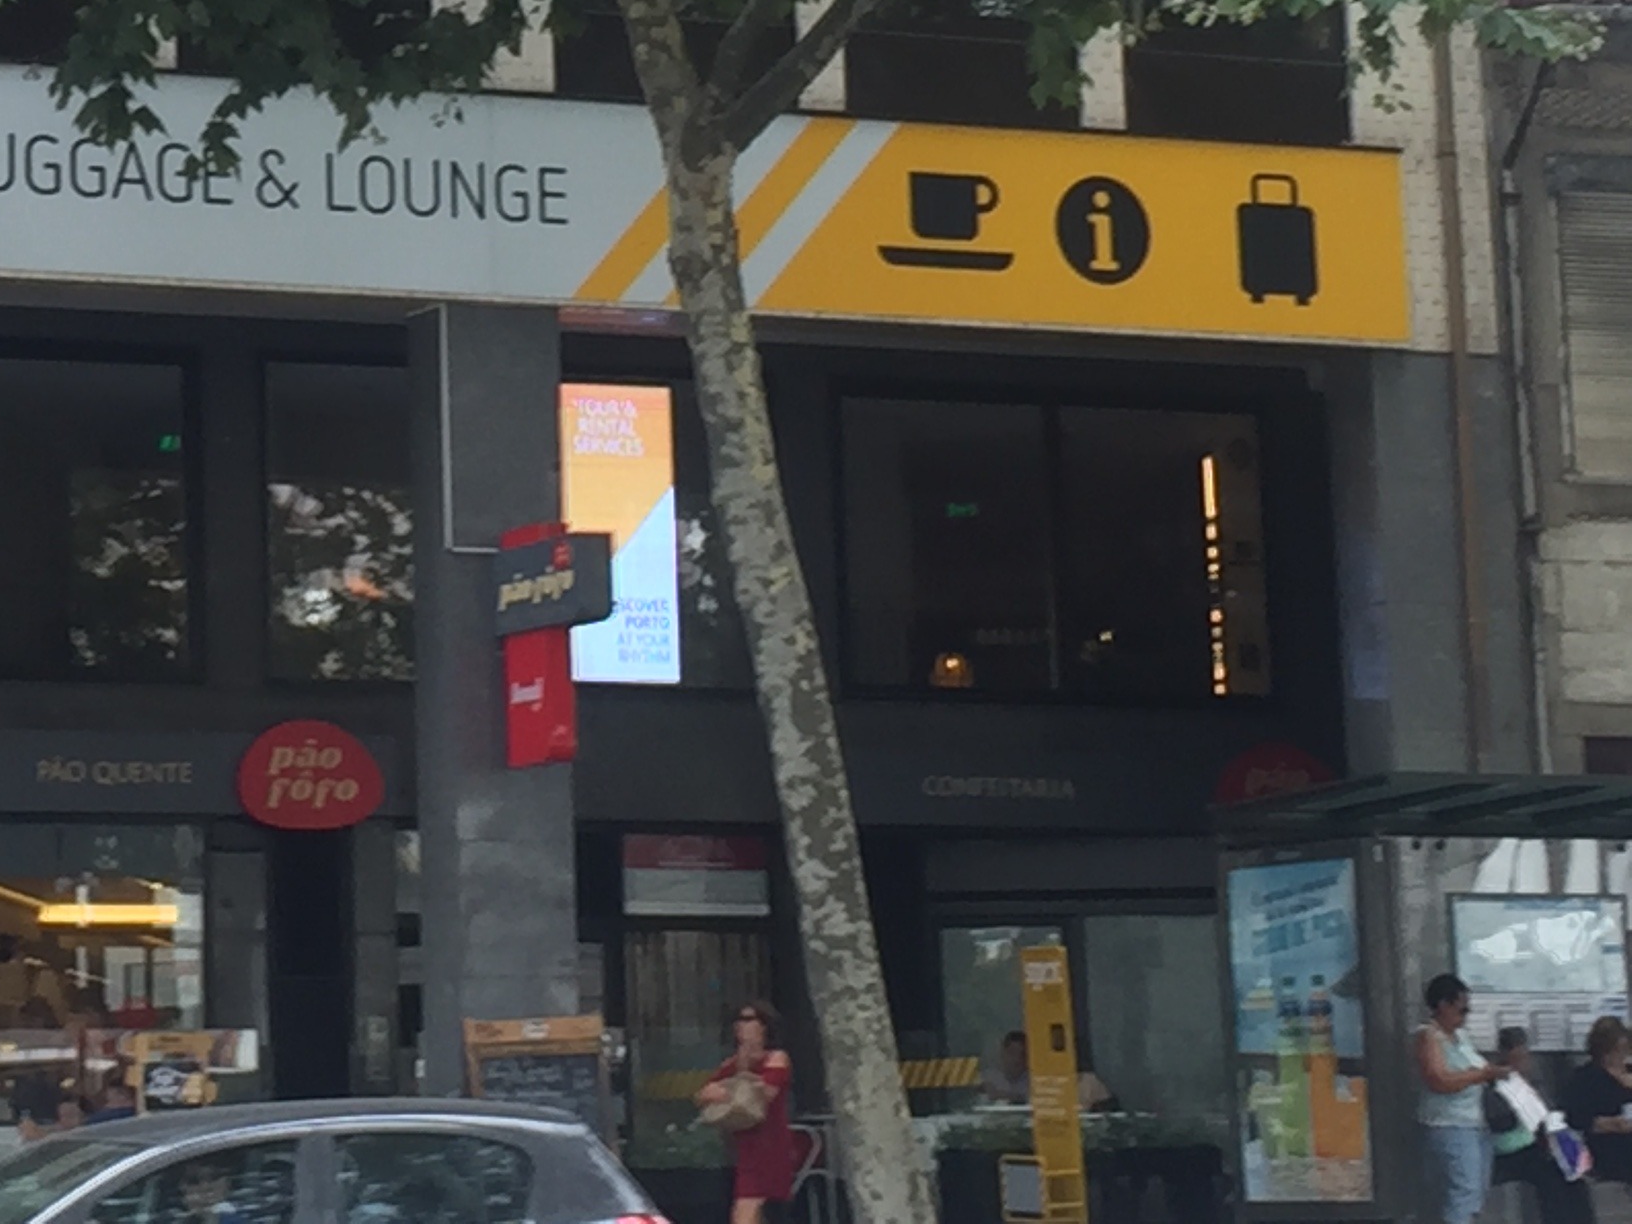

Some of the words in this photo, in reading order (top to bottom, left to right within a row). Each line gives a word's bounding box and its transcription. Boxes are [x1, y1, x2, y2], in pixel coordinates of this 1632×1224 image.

[255, 148, 301, 210] &
[325, 152, 570, 226] LOUNGE
[91, 760, 193, 785] QUENTE
[268, 739, 343, 775] pão
